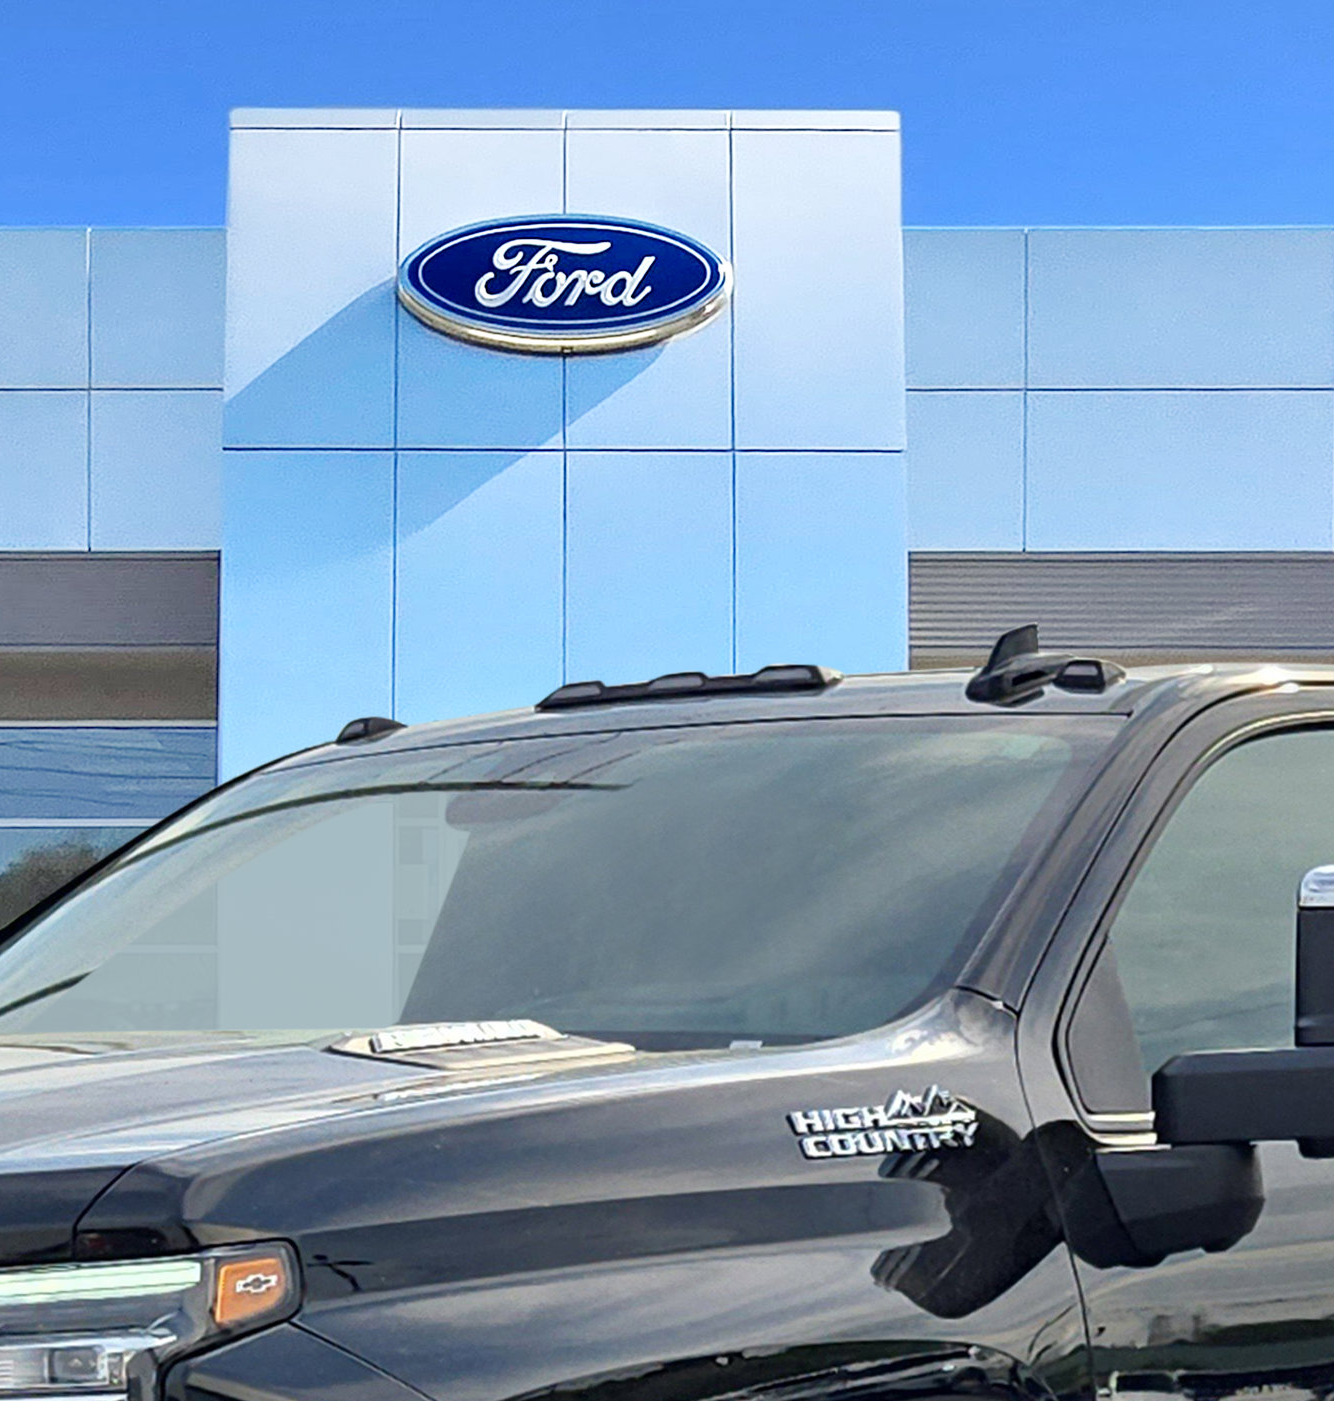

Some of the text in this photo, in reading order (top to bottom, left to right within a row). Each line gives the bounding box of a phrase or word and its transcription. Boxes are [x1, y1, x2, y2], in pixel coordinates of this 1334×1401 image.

[474, 239, 655, 307] Ford
[788, 1105, 887, 1135] HIGH
[801, 1122, 979, 1158] COUNTRY
